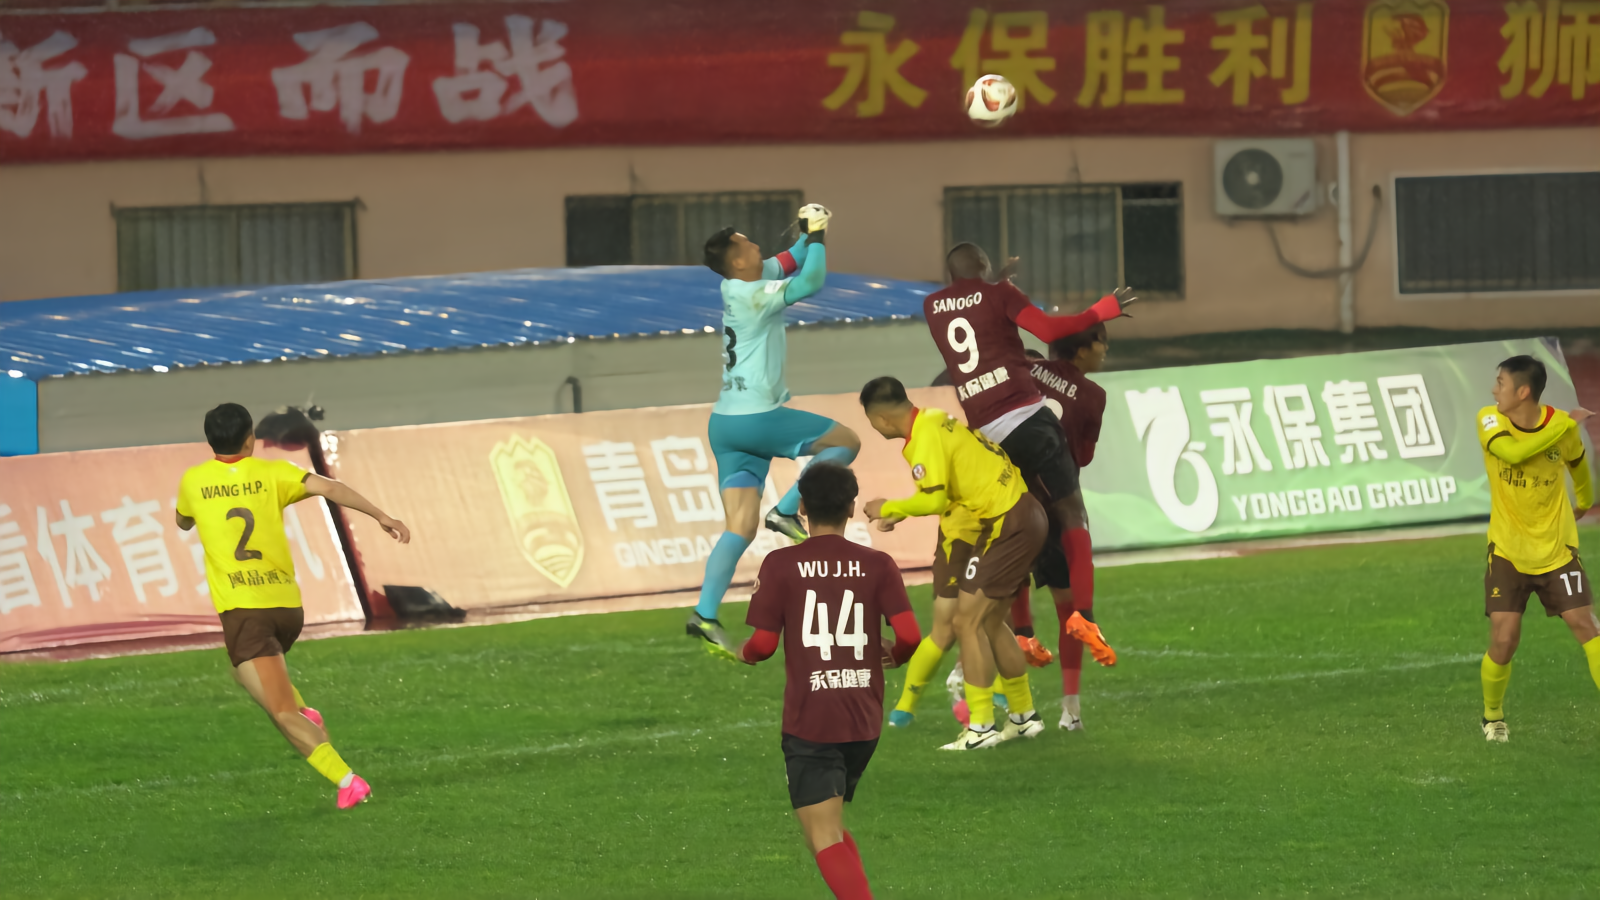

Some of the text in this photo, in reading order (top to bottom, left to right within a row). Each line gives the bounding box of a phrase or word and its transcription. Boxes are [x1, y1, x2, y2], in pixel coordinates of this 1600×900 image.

[822, 3, 1312, 118] 永保胜利
[932, 292, 983, 314] SANOGO
[947, 317, 980, 374] 9
[1030, 363, 1066, 393] ZANHAR
[1200, 373, 1446, 476] 永保集团
[201, 480, 268, 500] WANG H.P.
[1231, 475, 1457, 521] YONGBAO GROUP
[225, 507, 263, 562] 2
[797, 560, 866, 578] WU J.H.
[965, 556, 980, 580] 6
[1559, 570, 1583, 596] 17
[801, 589, 869, 661] 44
[809, 668, 871, 692] 永保健康
